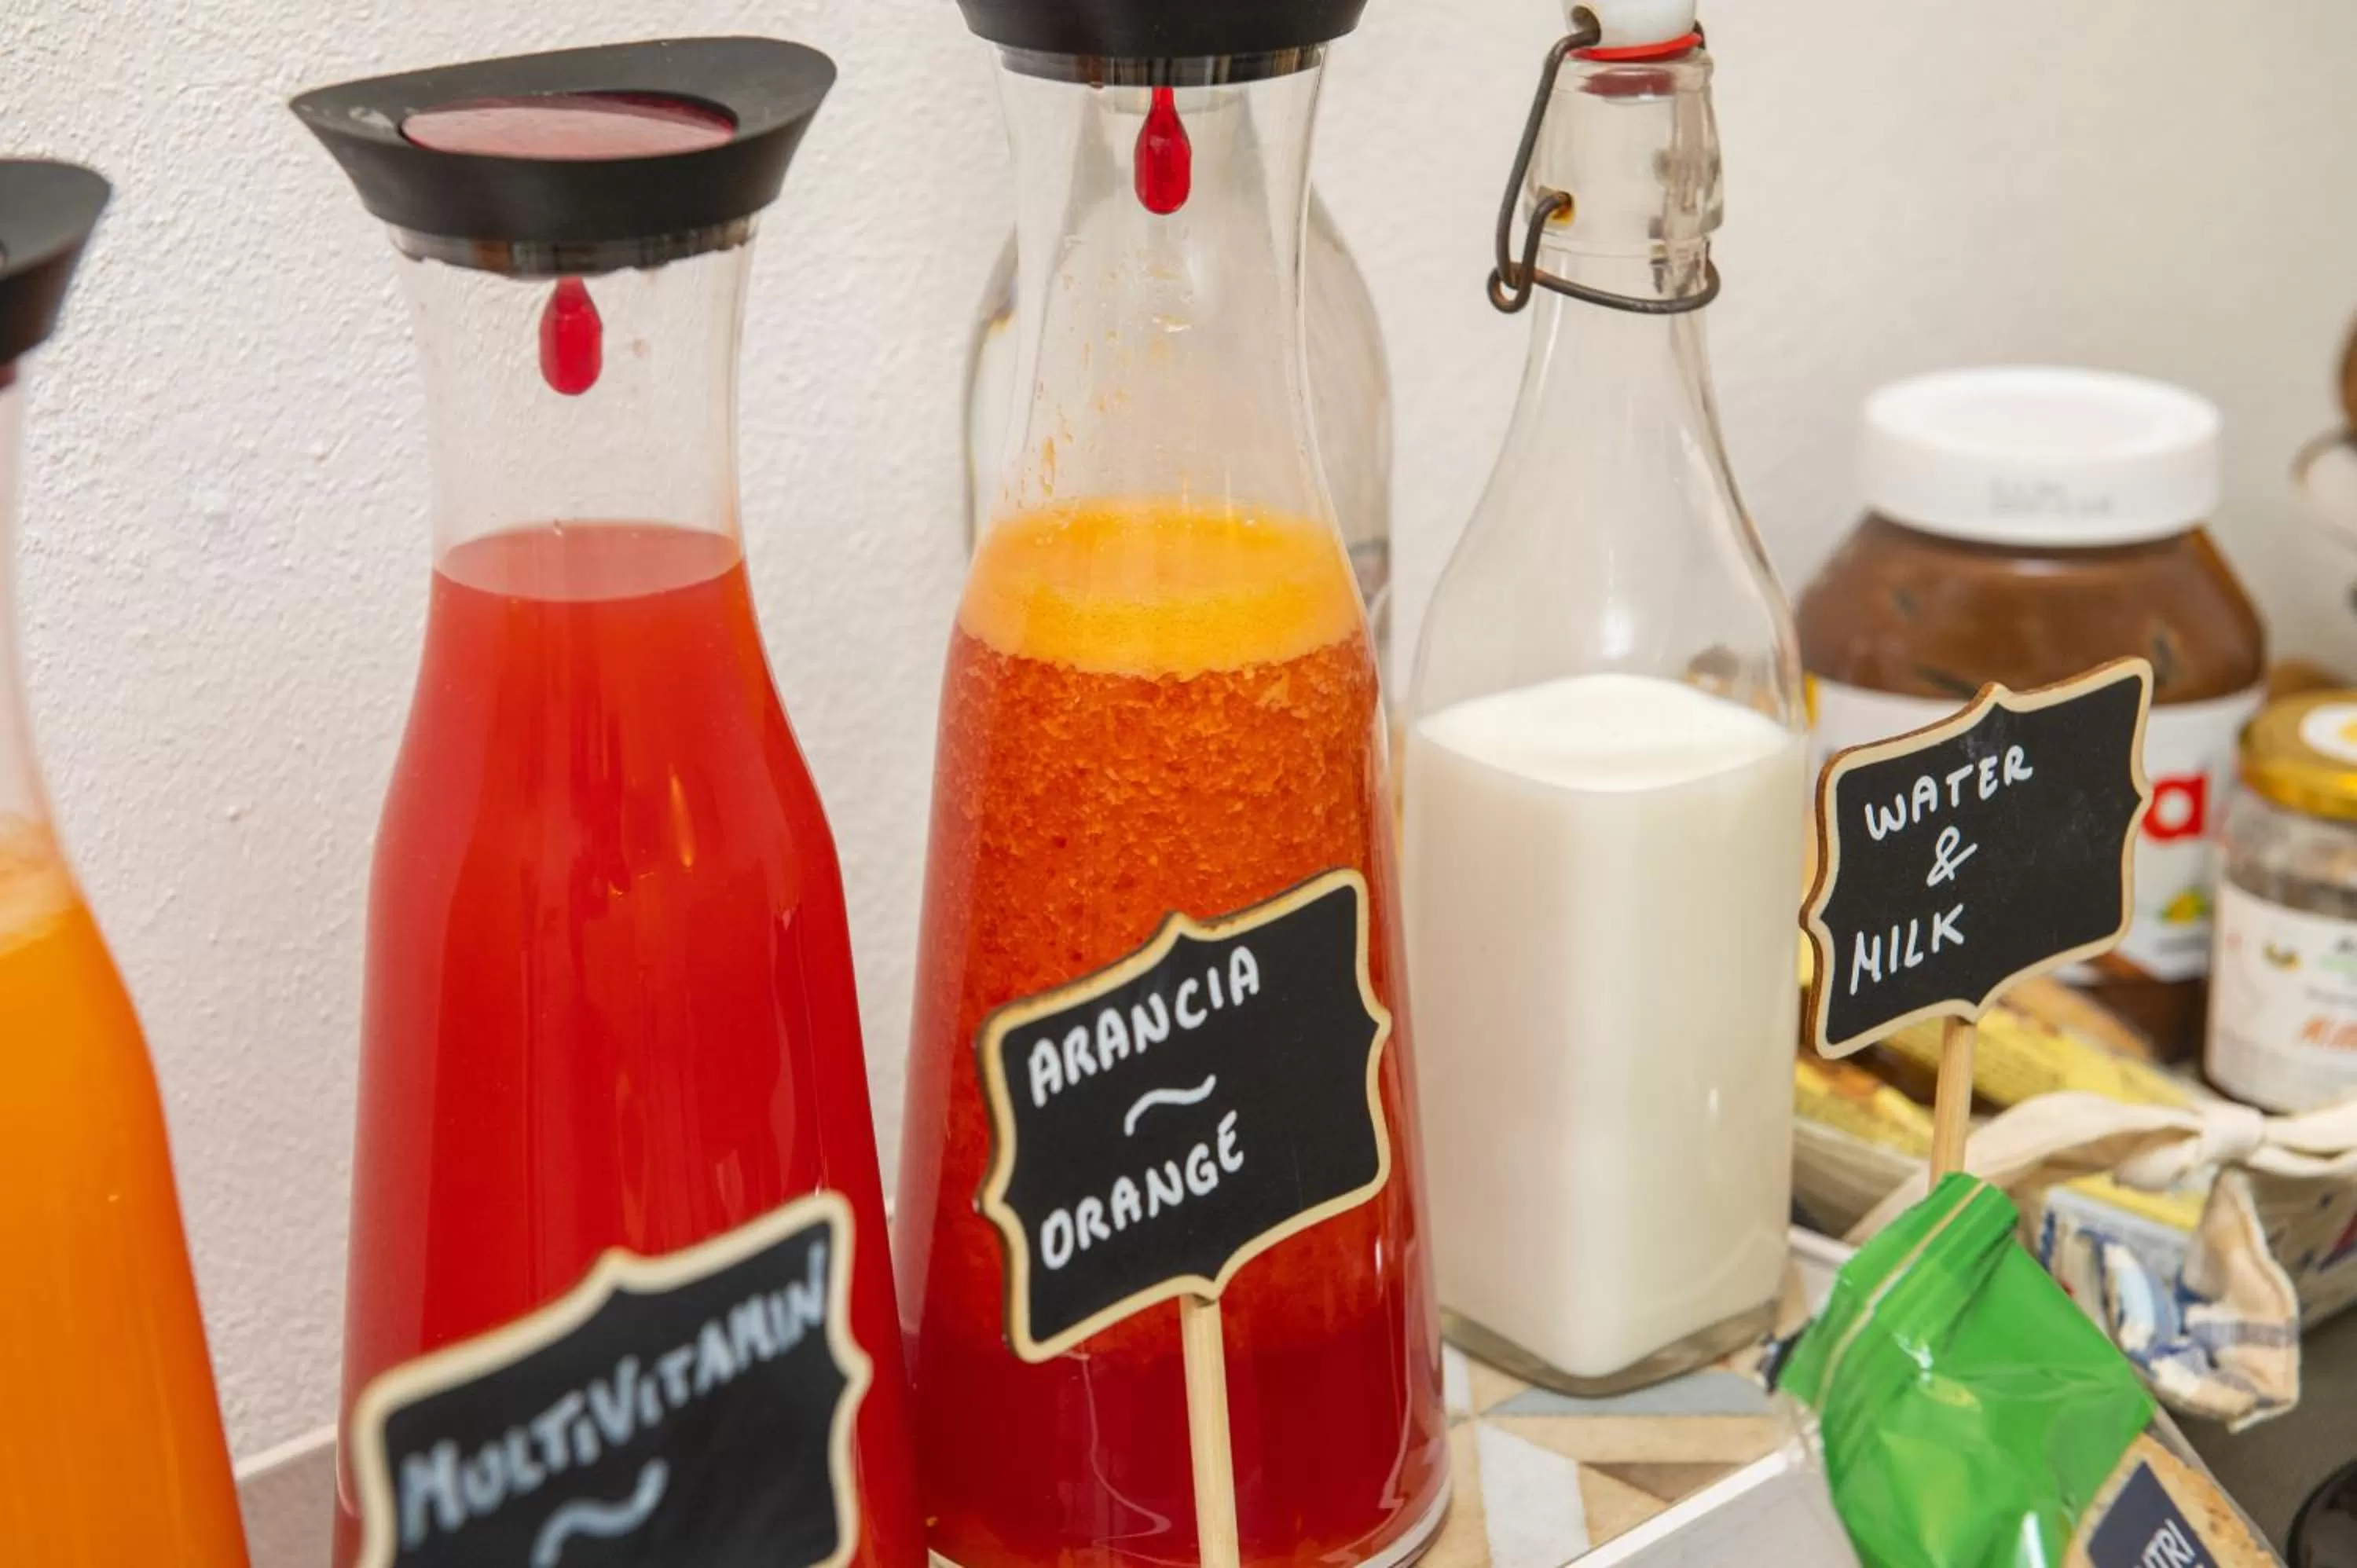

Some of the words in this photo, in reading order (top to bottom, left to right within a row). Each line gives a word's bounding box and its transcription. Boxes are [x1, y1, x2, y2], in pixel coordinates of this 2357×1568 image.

[1864, 745, 2034, 841] WATER
[1926, 826, 1978, 887] &
[1849, 903, 1964, 995] MILK
[1027, 946, 1260, 1108] ARANCIA
[1039, 1110, 1244, 1269] ORANGE
[2132, 1518, 2197, 1568] TRI
